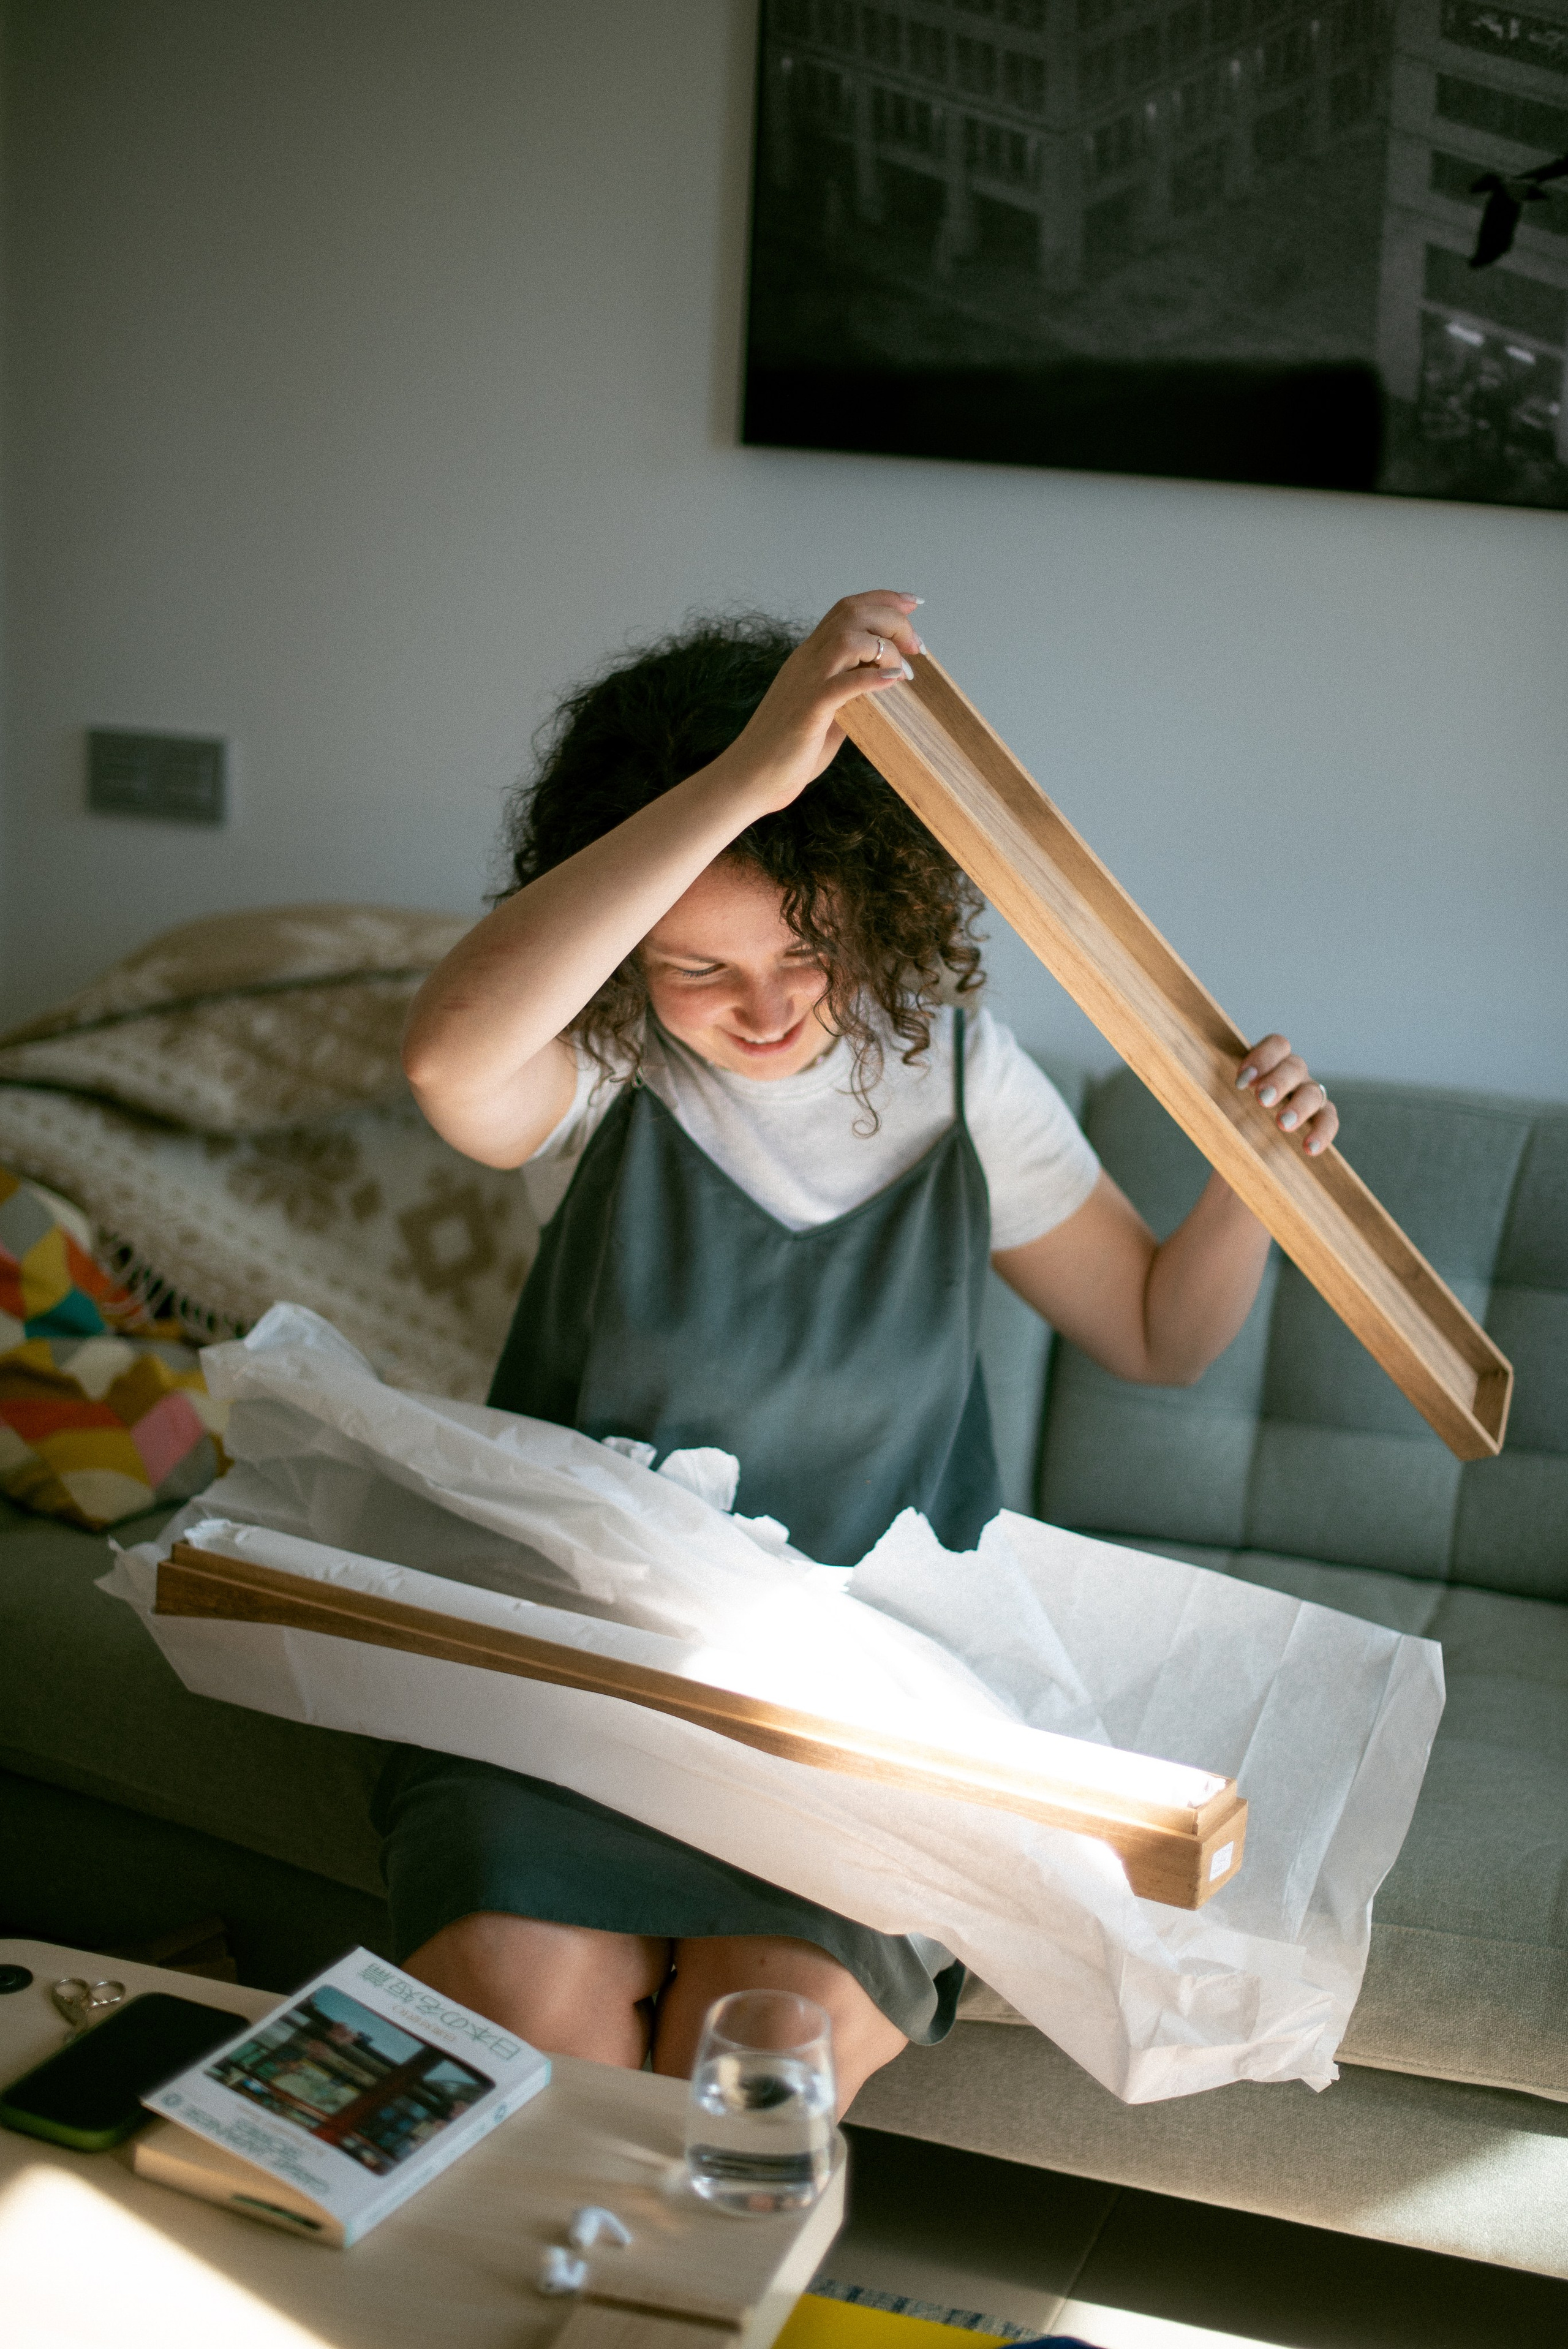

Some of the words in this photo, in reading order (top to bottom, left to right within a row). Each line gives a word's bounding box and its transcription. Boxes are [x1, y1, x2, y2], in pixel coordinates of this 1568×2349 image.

[356, 1962, 521, 2061] 日本の名短篇
